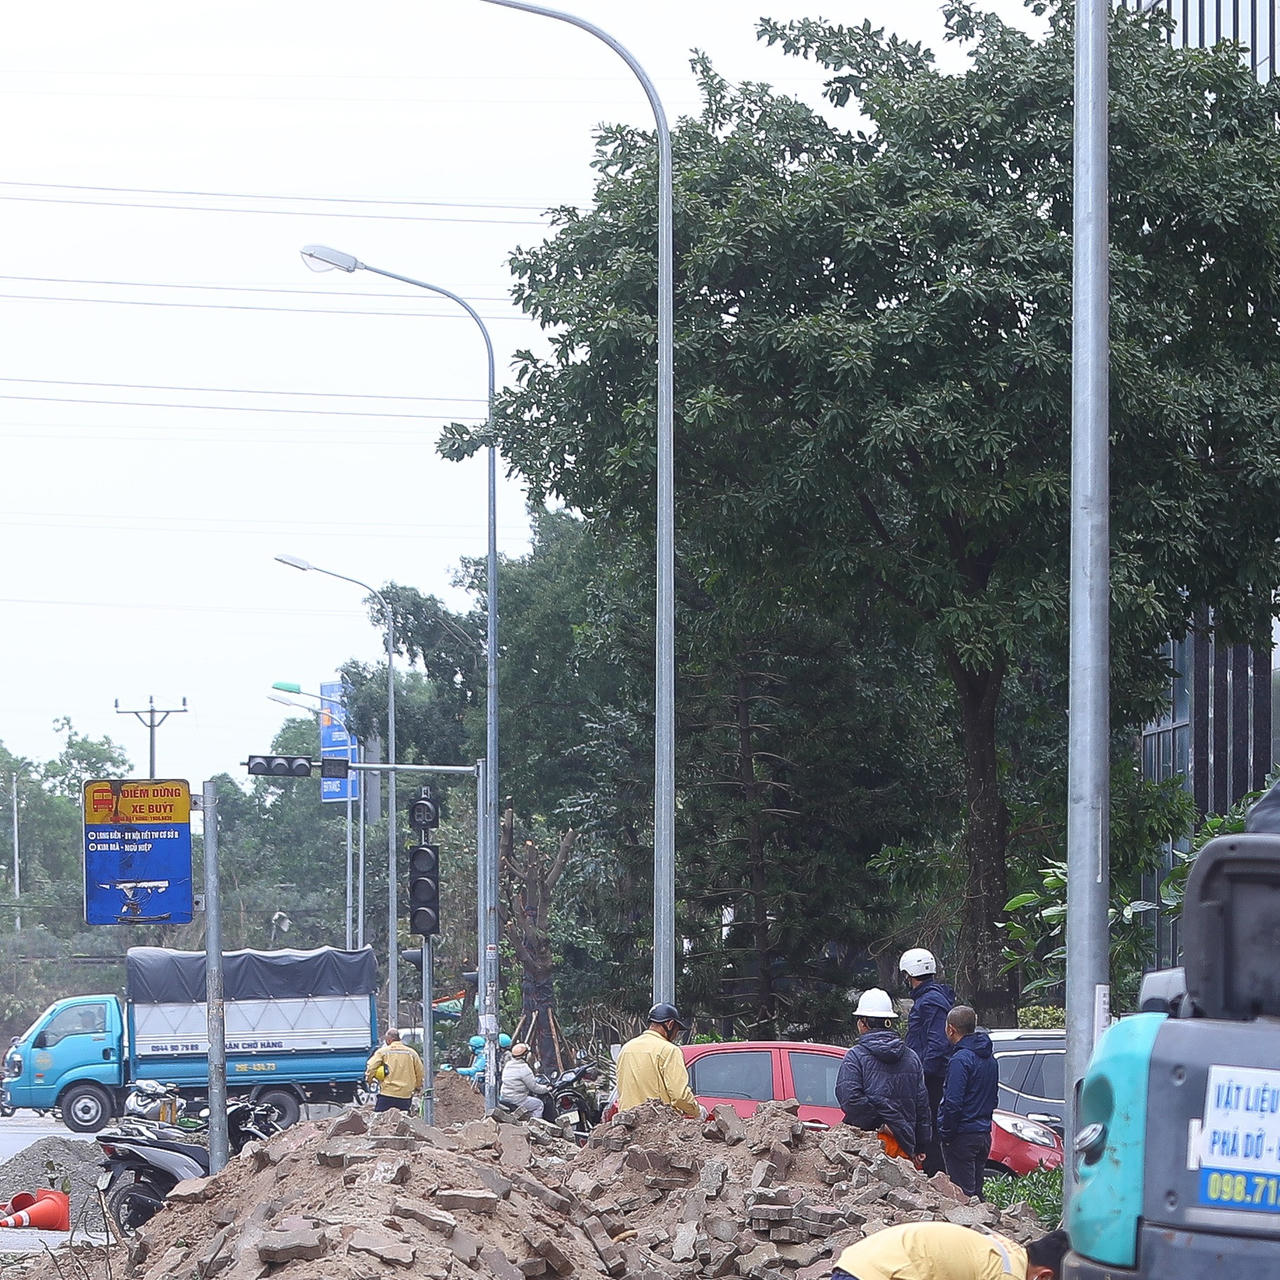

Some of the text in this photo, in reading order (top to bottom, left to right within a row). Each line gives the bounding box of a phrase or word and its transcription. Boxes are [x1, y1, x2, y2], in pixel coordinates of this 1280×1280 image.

[152, 786, 180, 797] DỪNG
[132, 802, 174, 813] XE BUÝT
[1216, 1079, 1240, 1116] VẬT
[1246, 1082, 1279, 1120] LIỆU
[1211, 1127, 1240, 1158] PHÁ
